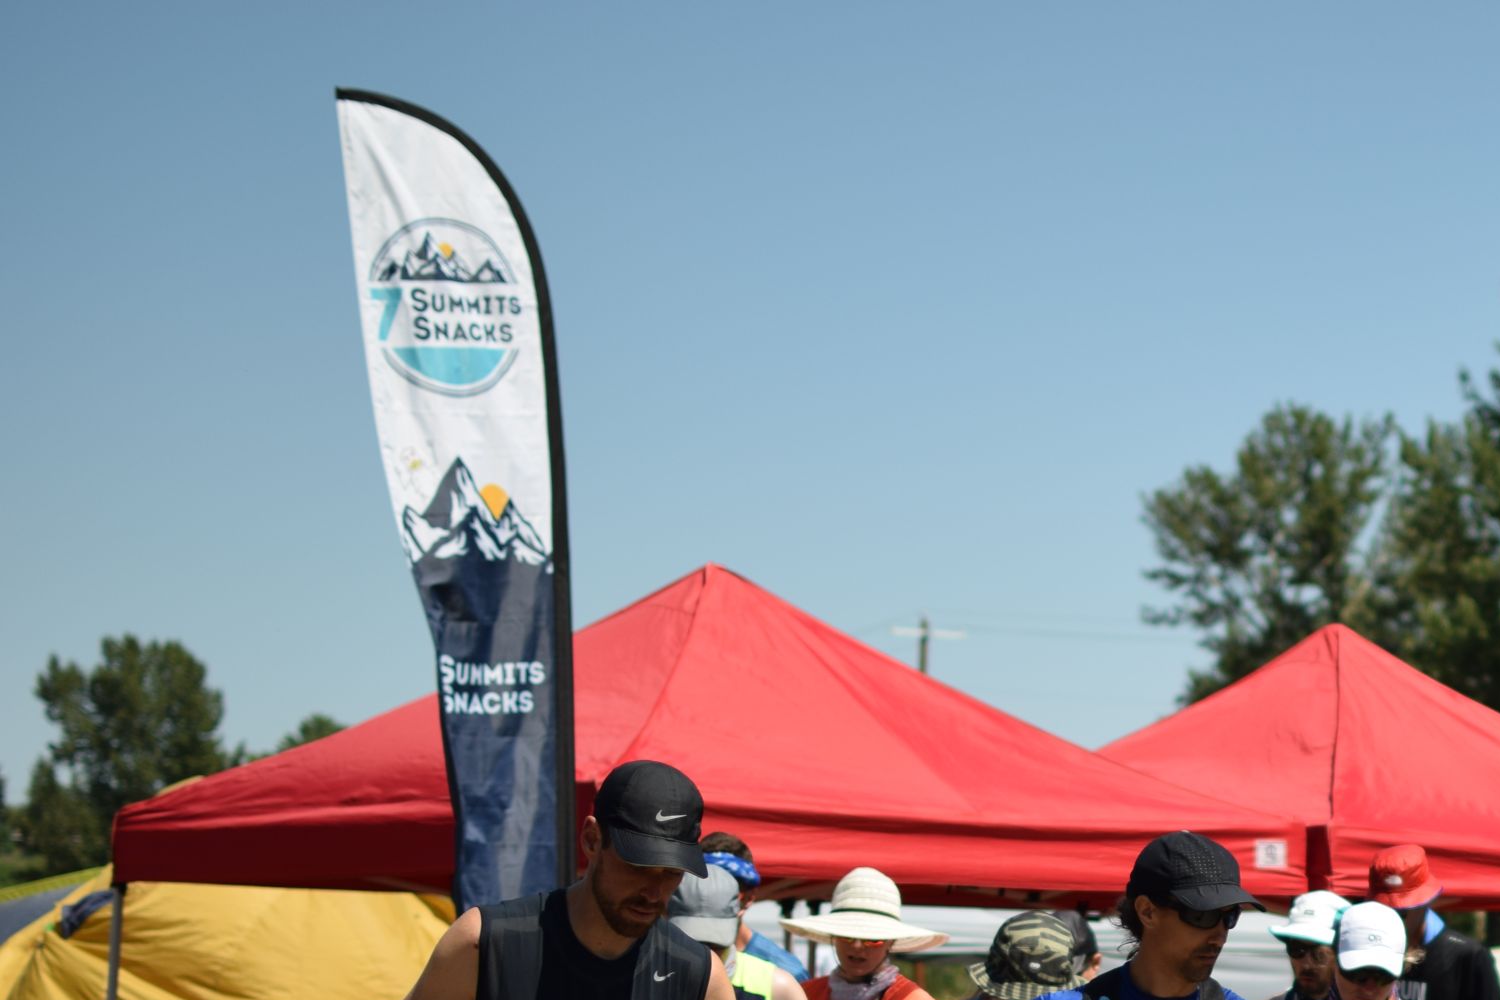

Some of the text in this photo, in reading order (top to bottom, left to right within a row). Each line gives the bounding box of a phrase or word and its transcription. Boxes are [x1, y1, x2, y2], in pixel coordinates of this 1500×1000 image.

[370, 287, 402, 341] 7
[411, 288, 521, 315] SUMMITS
[413, 316, 513, 342] SNACKS
[440, 654, 545, 686] SUMMITS
[443, 684, 535, 715] SNACKS
